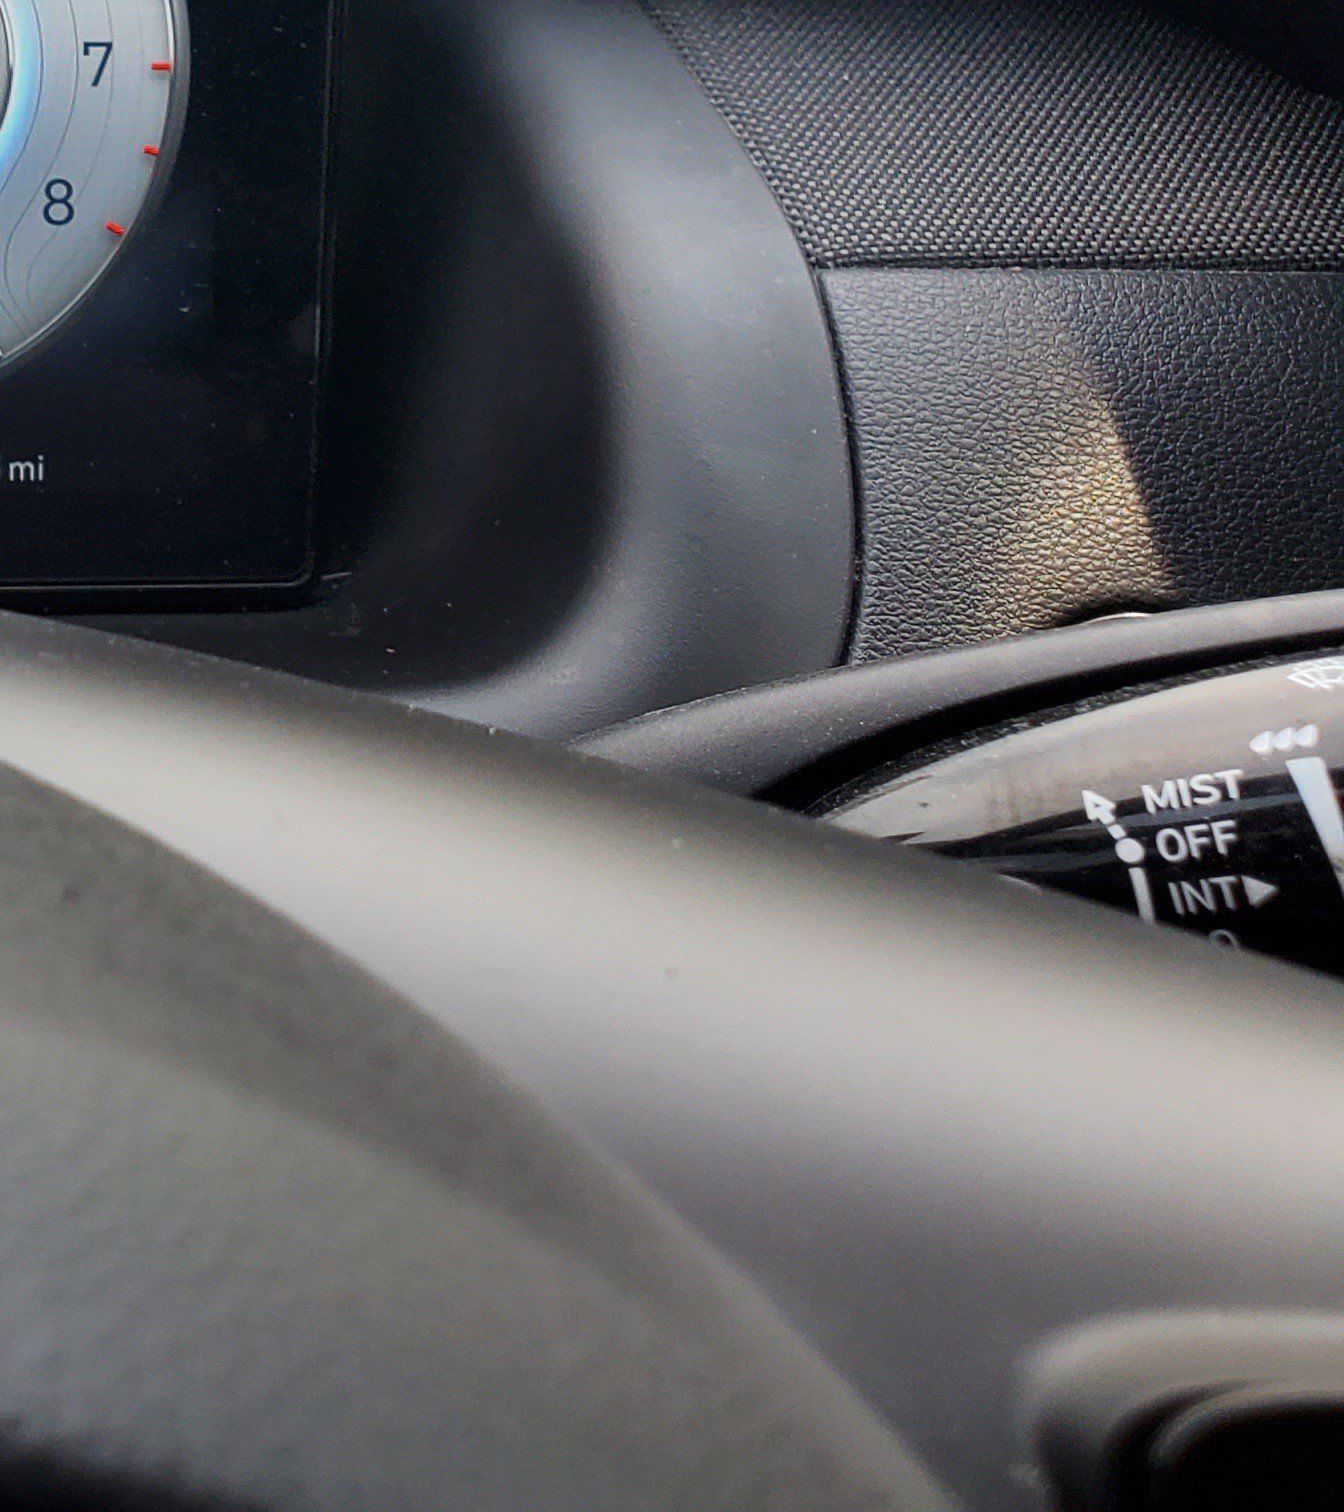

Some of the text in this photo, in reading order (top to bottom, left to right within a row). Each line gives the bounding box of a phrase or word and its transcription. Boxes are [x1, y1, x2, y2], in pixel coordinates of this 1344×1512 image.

[82, 41, 114, 88] 7
[42, 179, 76, 226] 8
[8, 454, 45, 484] mi
[1142, 770, 1243, 814] MIST
[1156, 820, 1237, 863] OFF
[1167, 875, 1238, 916] INT
